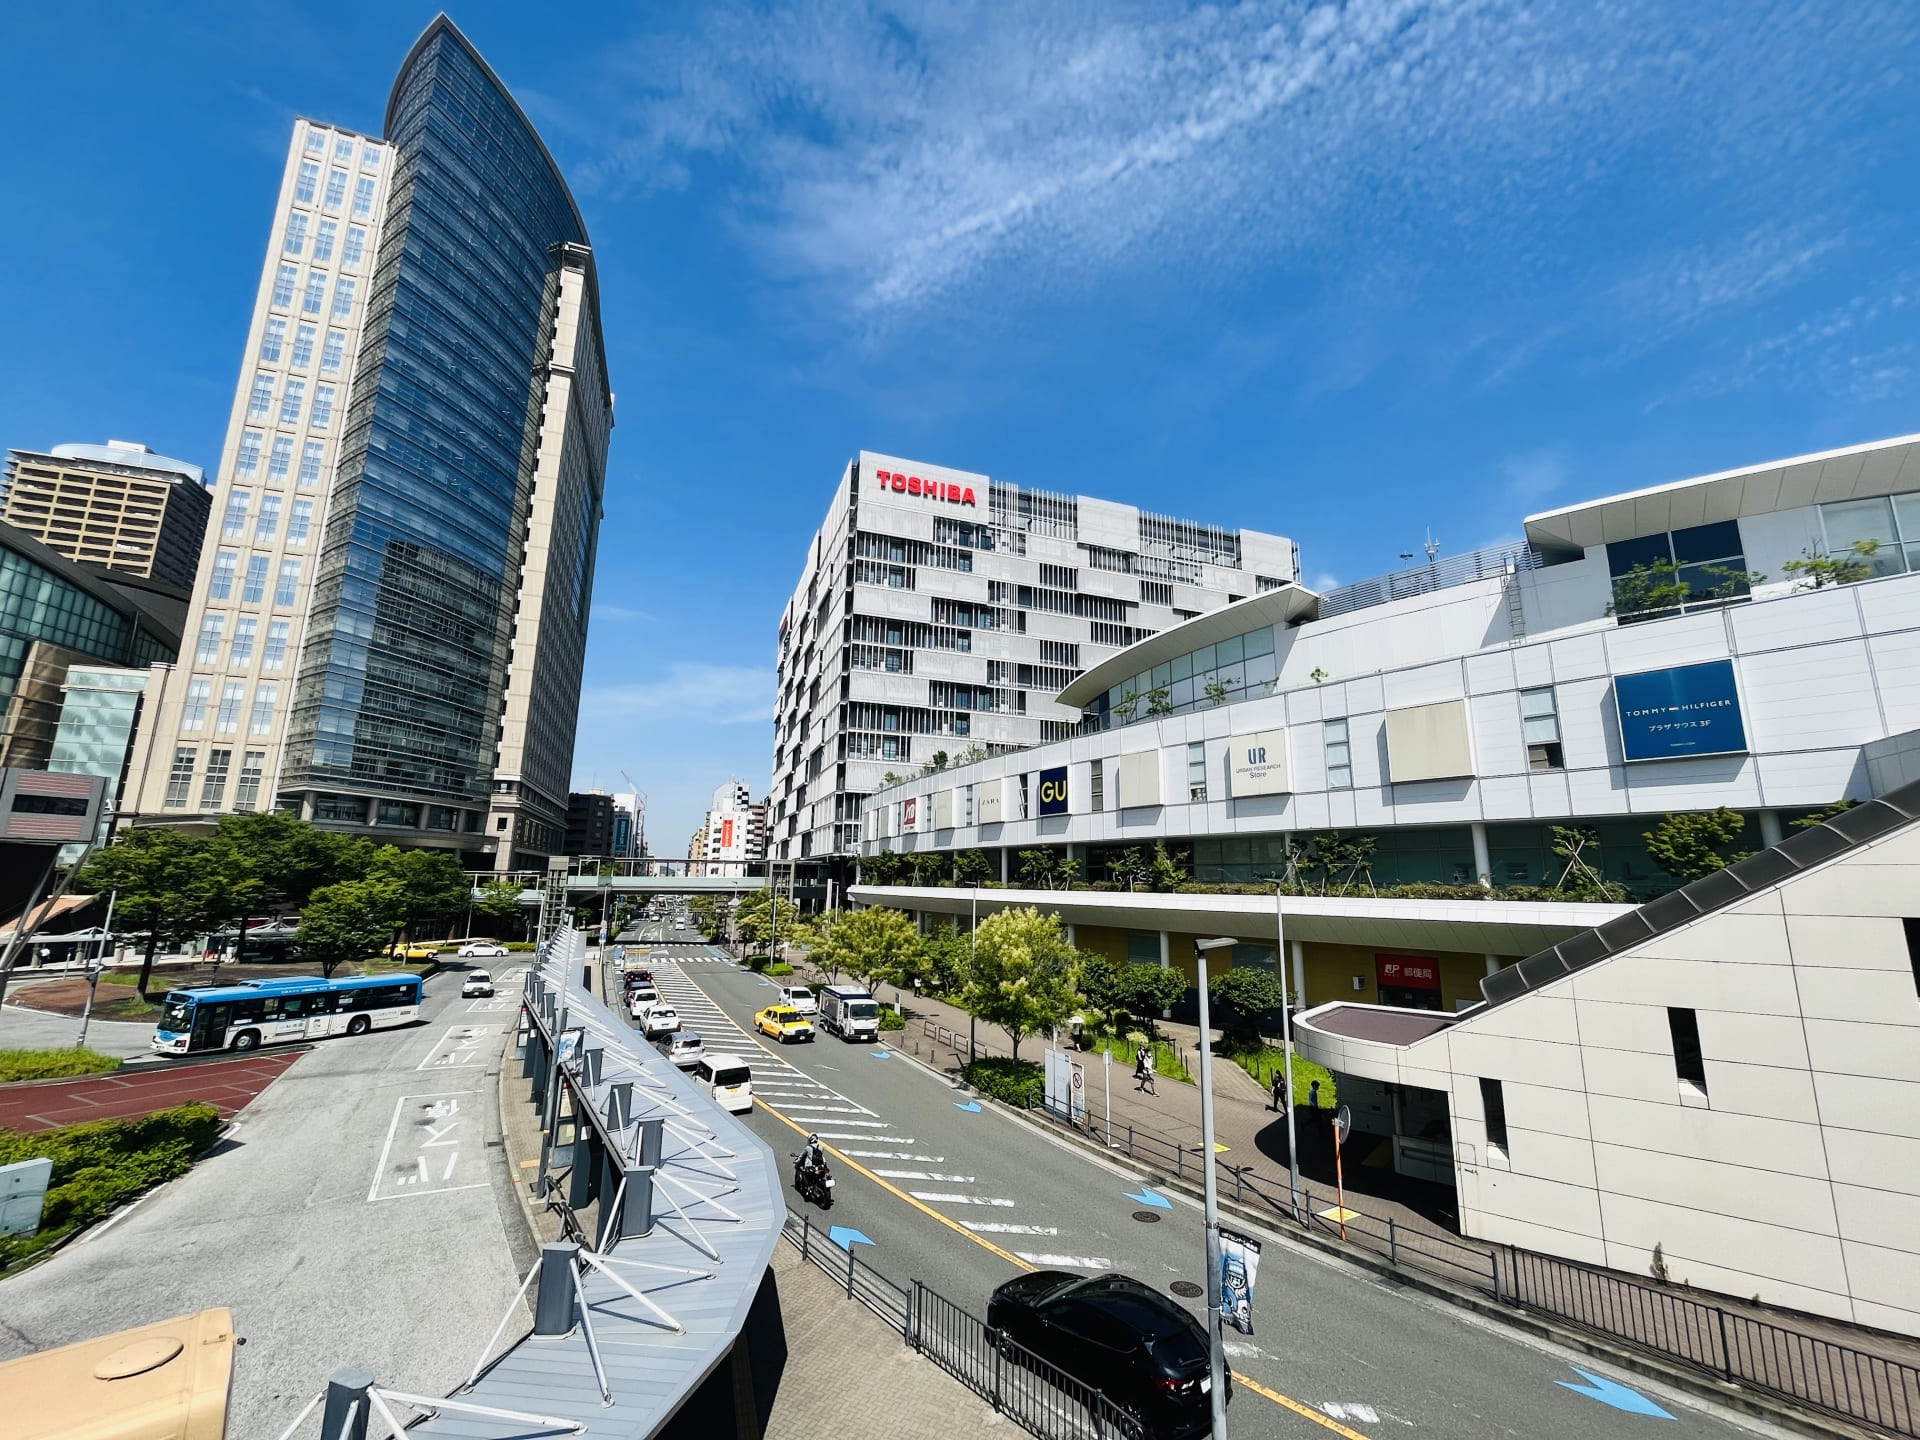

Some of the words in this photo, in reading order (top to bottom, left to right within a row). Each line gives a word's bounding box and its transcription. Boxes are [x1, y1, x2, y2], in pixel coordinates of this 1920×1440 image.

[876, 470, 976, 506] TOSHIBA
[1626, 708, 1666, 717] TOMMY
[1681, 700, 1732, 711] HILFIGER
[1699, 719, 1712, 728] 3F
[1248, 747, 1266, 764] UR
[1041, 779, 1067, 803] GU
[1404, 967, 1432, 979] 郵便局
